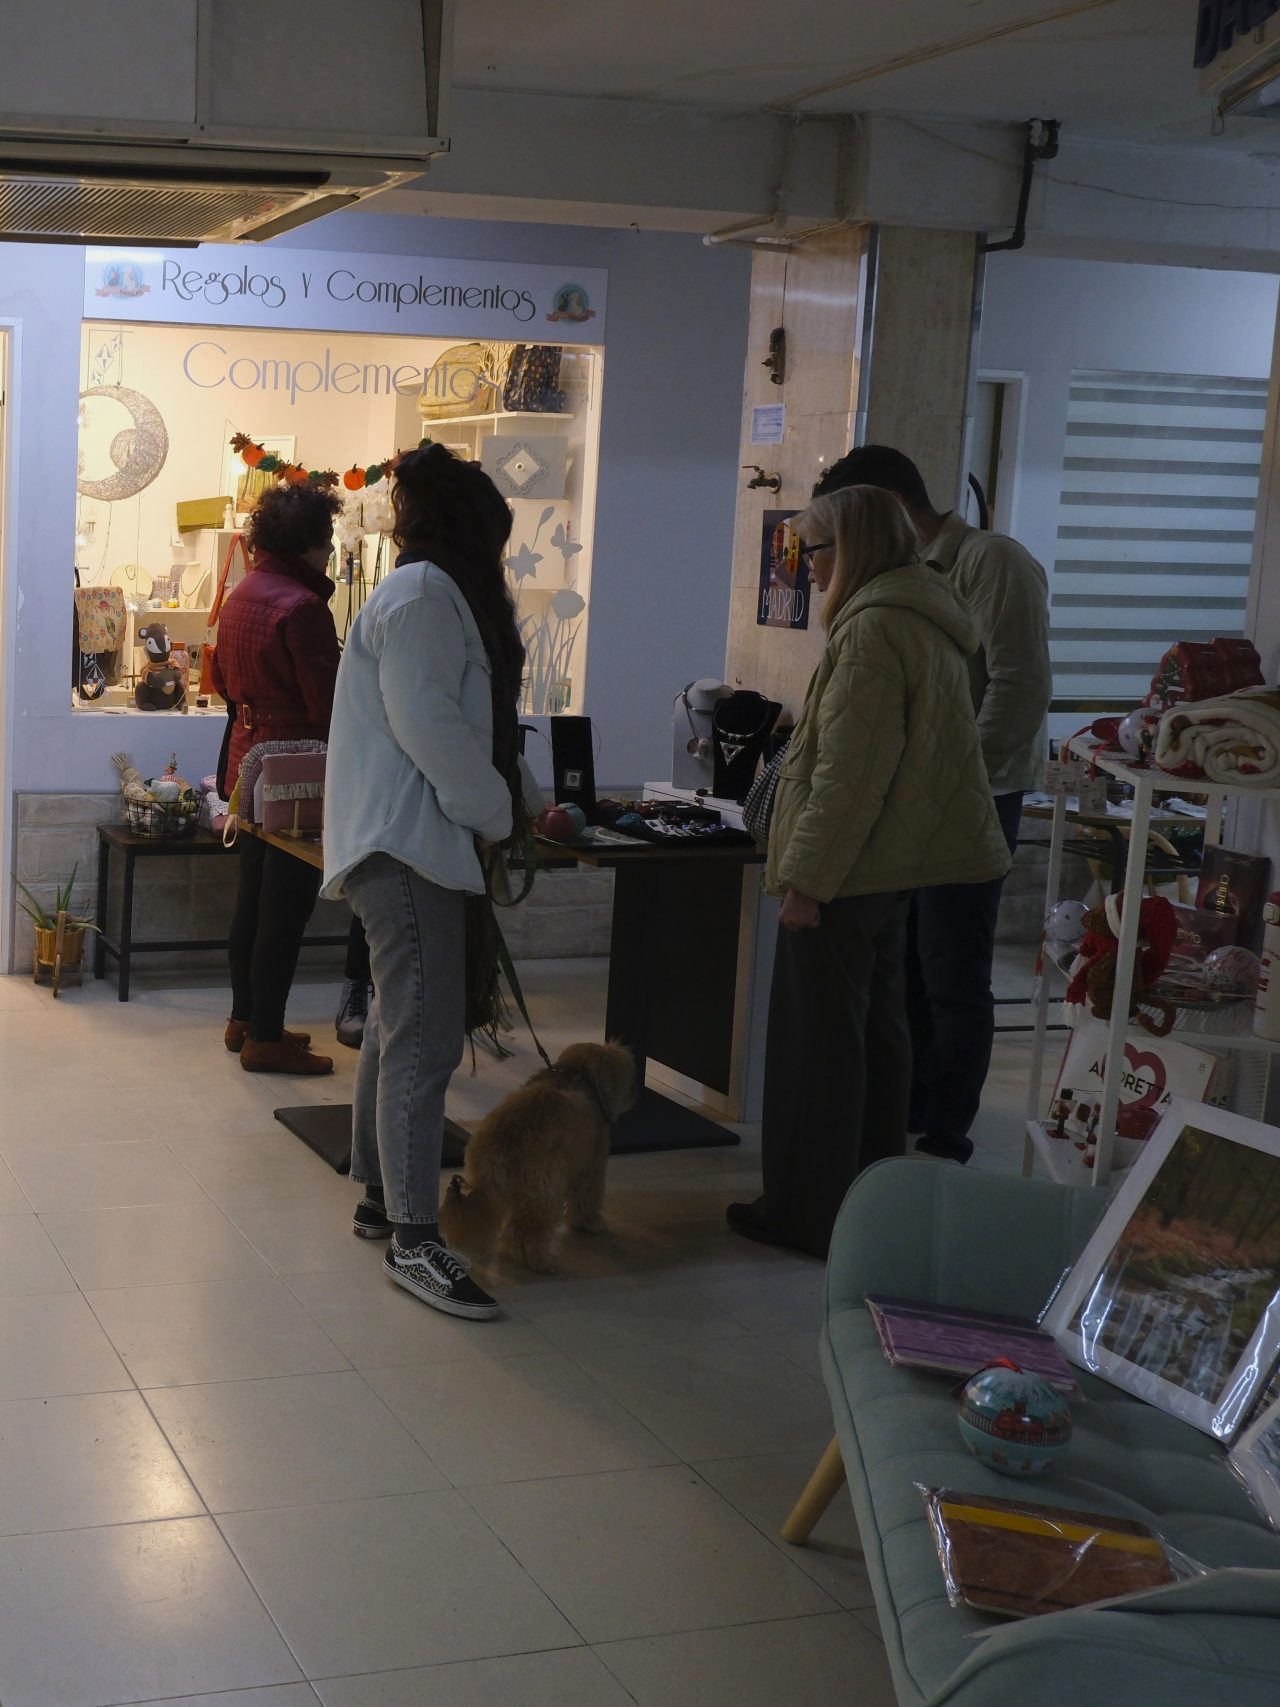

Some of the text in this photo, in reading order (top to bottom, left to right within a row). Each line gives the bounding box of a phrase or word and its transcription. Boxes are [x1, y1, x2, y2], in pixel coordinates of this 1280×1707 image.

[162, 259, 286, 308] Regalos
[327, 269, 537, 322] Complementos
[761, 587, 804, 622] MADRID
